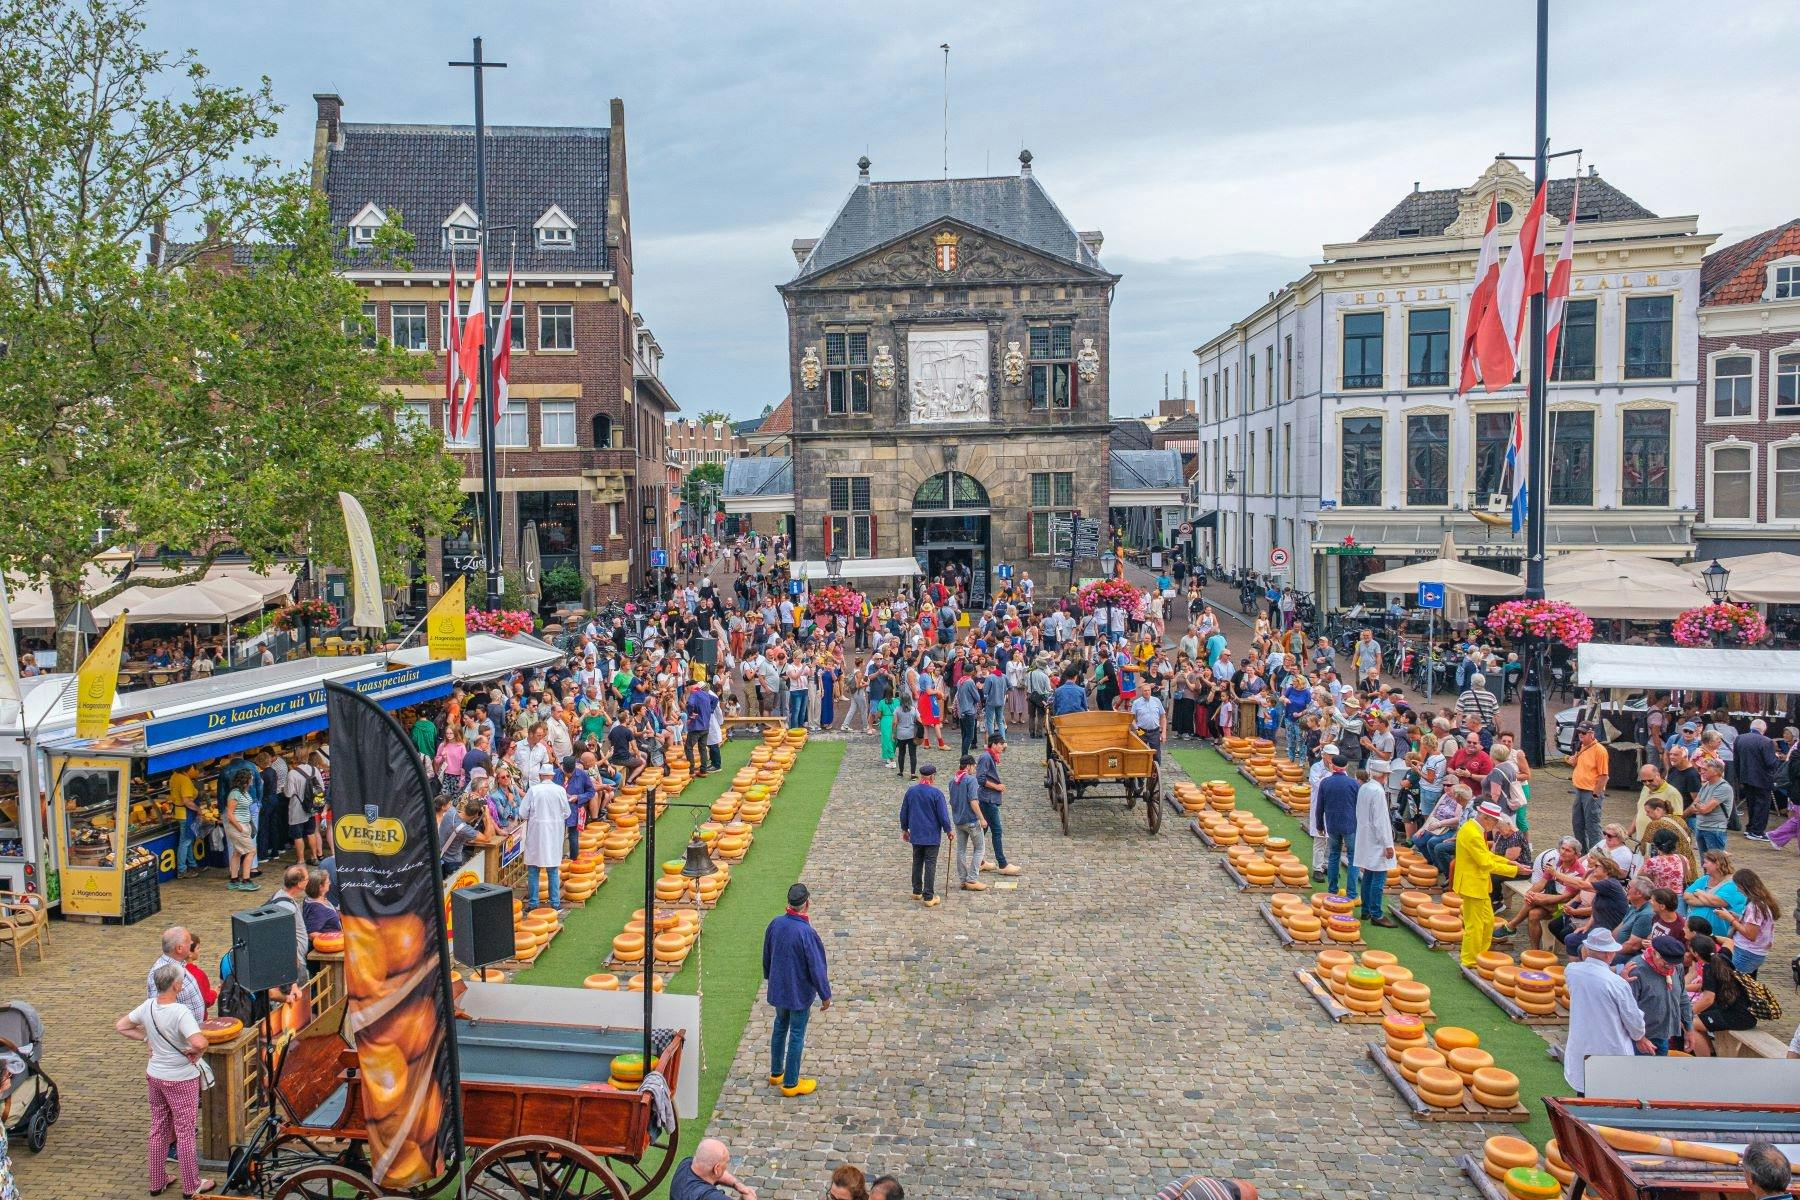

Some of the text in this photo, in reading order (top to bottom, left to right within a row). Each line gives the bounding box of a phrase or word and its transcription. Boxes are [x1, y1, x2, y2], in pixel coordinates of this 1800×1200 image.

[1356, 287, 1448, 304] HOTEL
[1575, 274, 1659, 290] ZALM
[208, 713, 226, 728] De
[231, 702, 286, 723] kaasboer
[290, 695, 305, 709] uit
[356, 671, 420, 693] kaasspecialist
[341, 825, 399, 842] VERGEER
[78, 889, 112, 898] Hagendoorn
